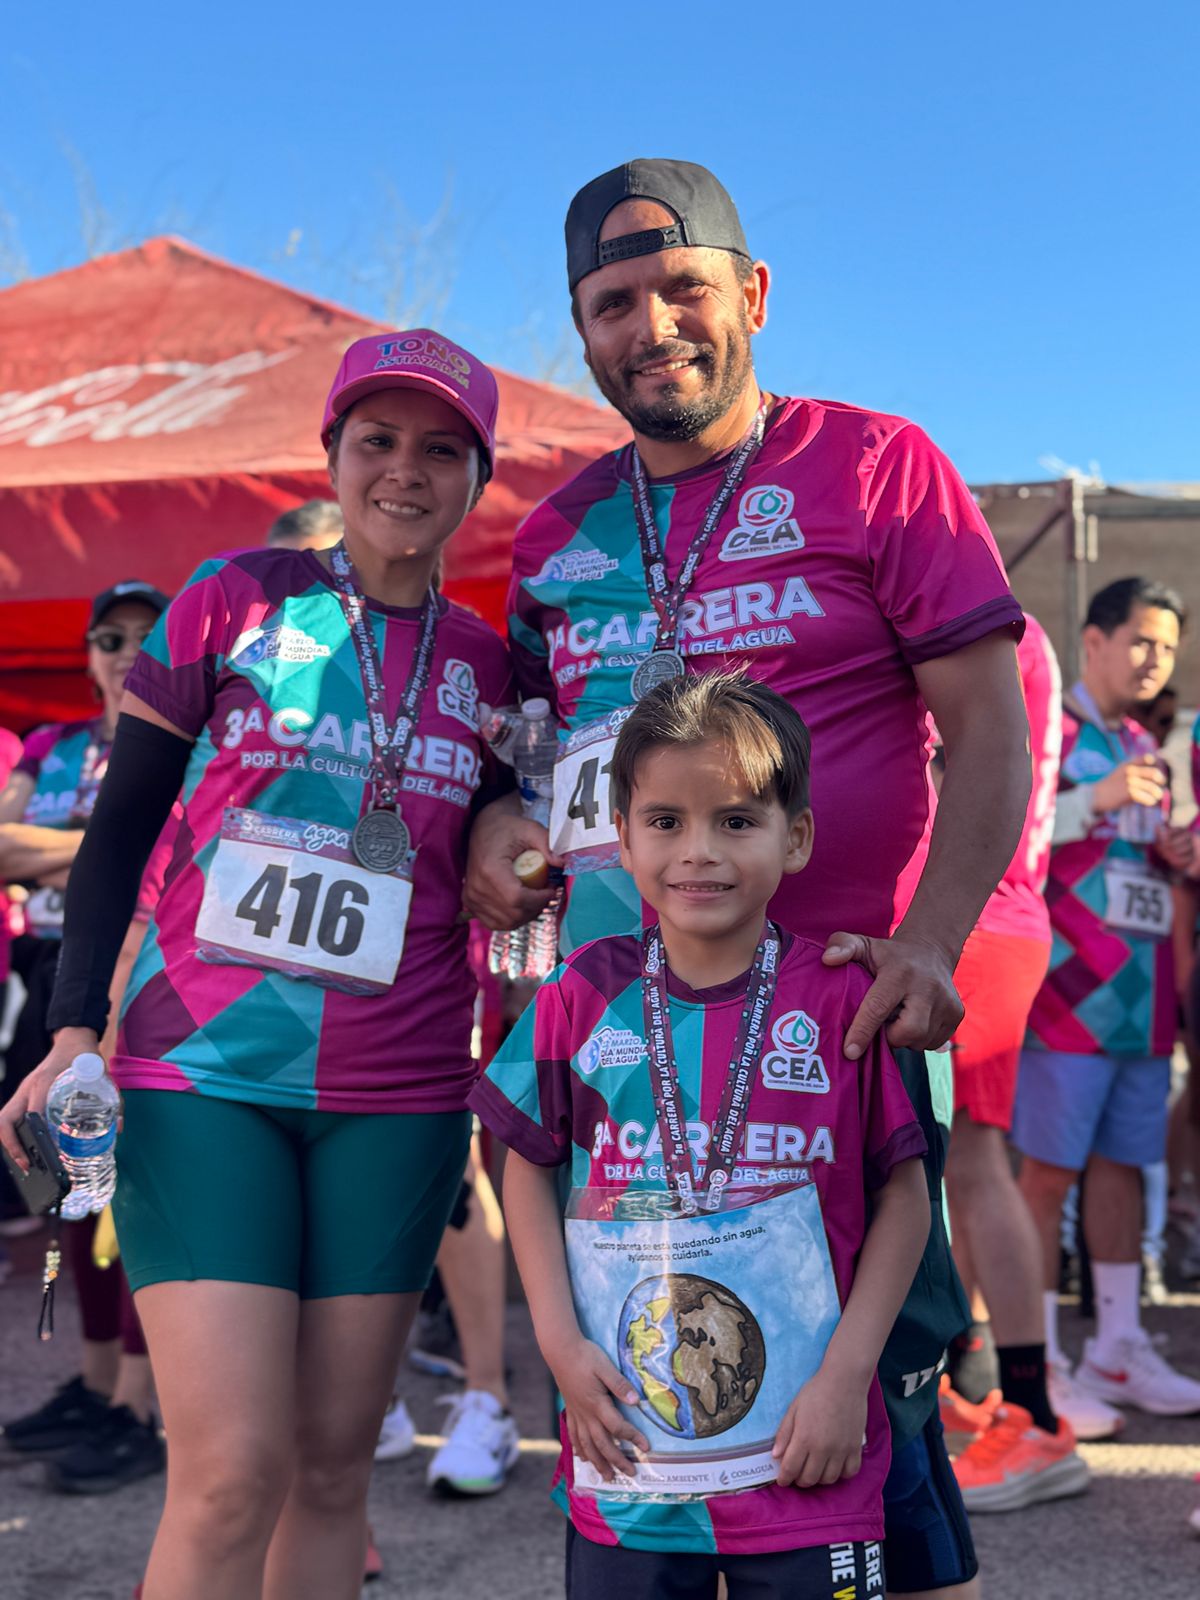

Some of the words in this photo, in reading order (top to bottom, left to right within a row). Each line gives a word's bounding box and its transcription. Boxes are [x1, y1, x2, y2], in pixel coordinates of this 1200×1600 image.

[730, 450, 749, 479] CULTURA
[728, 522, 798, 548] CEA
[690, 638, 726, 655] DEL
[729, 625, 796, 652] AGUA
[240, 751, 276, 769] POR
[280, 752, 306, 769] LA
[402, 776, 438, 795] DEL
[440, 783, 472, 809] AGU
[303, 824, 349, 852] agua
[235, 863, 369, 957] 416
[1121, 882, 1164, 923] 755
[650, 986, 661, 1009] AGUA
[652, 1010, 663, 1026] DEL
[748, 998, 766, 1037] CARRERA
[616, 1046, 647, 1055] MUNDIA
[654, 1027, 668, 1065] CULTURA
[743, 1036, 756, 1055] POR
[615, 1055, 639, 1064] AGUA
[659, 1066, 670, 1078] LA
[740, 1056, 752, 1067] LA
[767, 1055, 824, 1083] CEA
[661, 1078, 673, 1098] POR
[731, 1068, 749, 1107] CULTURA
[665, 1099, 682, 1142] CARRERA
[726, 1109, 739, 1126] DEL
[720, 1127, 734, 1153] AGUA
[626, 1163, 644, 1180] LA
[672, 1236, 721, 1250] quedando
[723, 1232, 738, 1242] sin
[731, 1463, 774, 1479] CONAGUA
